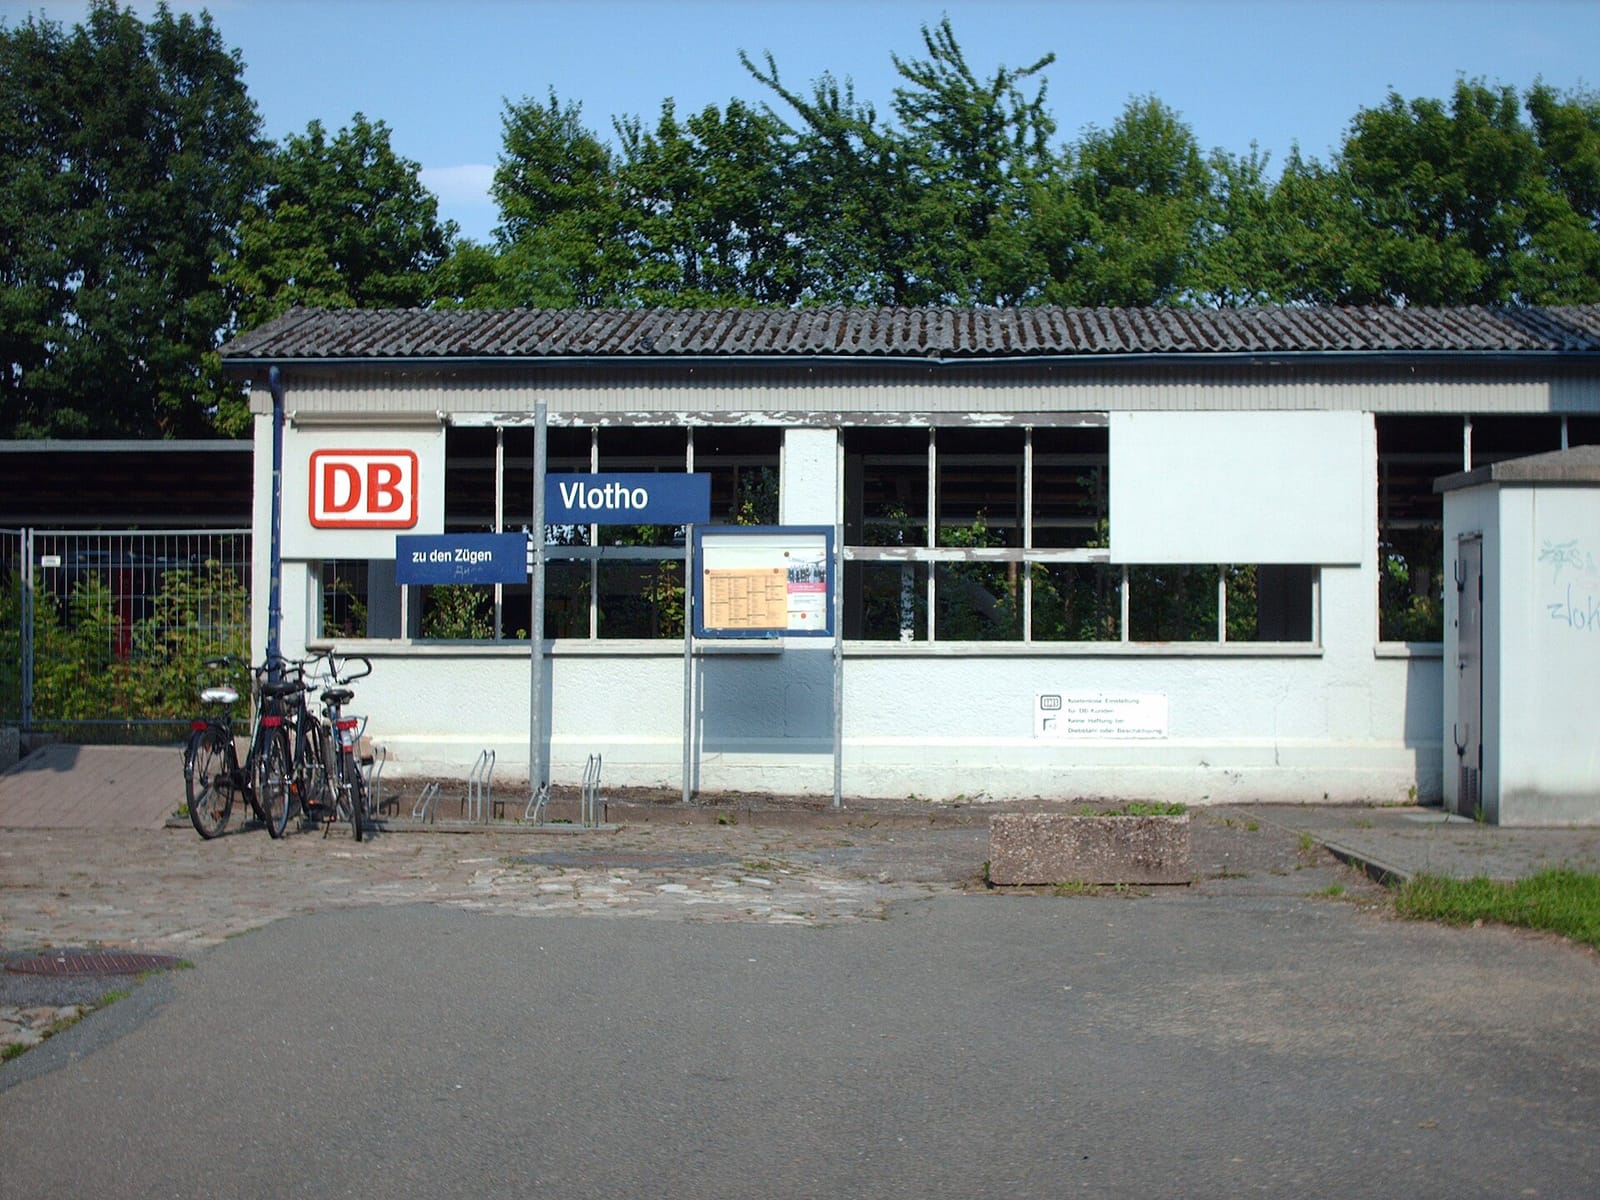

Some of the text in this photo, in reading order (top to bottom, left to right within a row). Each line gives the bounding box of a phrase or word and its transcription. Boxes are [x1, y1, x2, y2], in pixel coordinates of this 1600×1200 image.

[323, 462, 404, 513] DB
[559, 482, 649, 509] Vlotho
[412, 548, 492, 564] zu den Zügen
